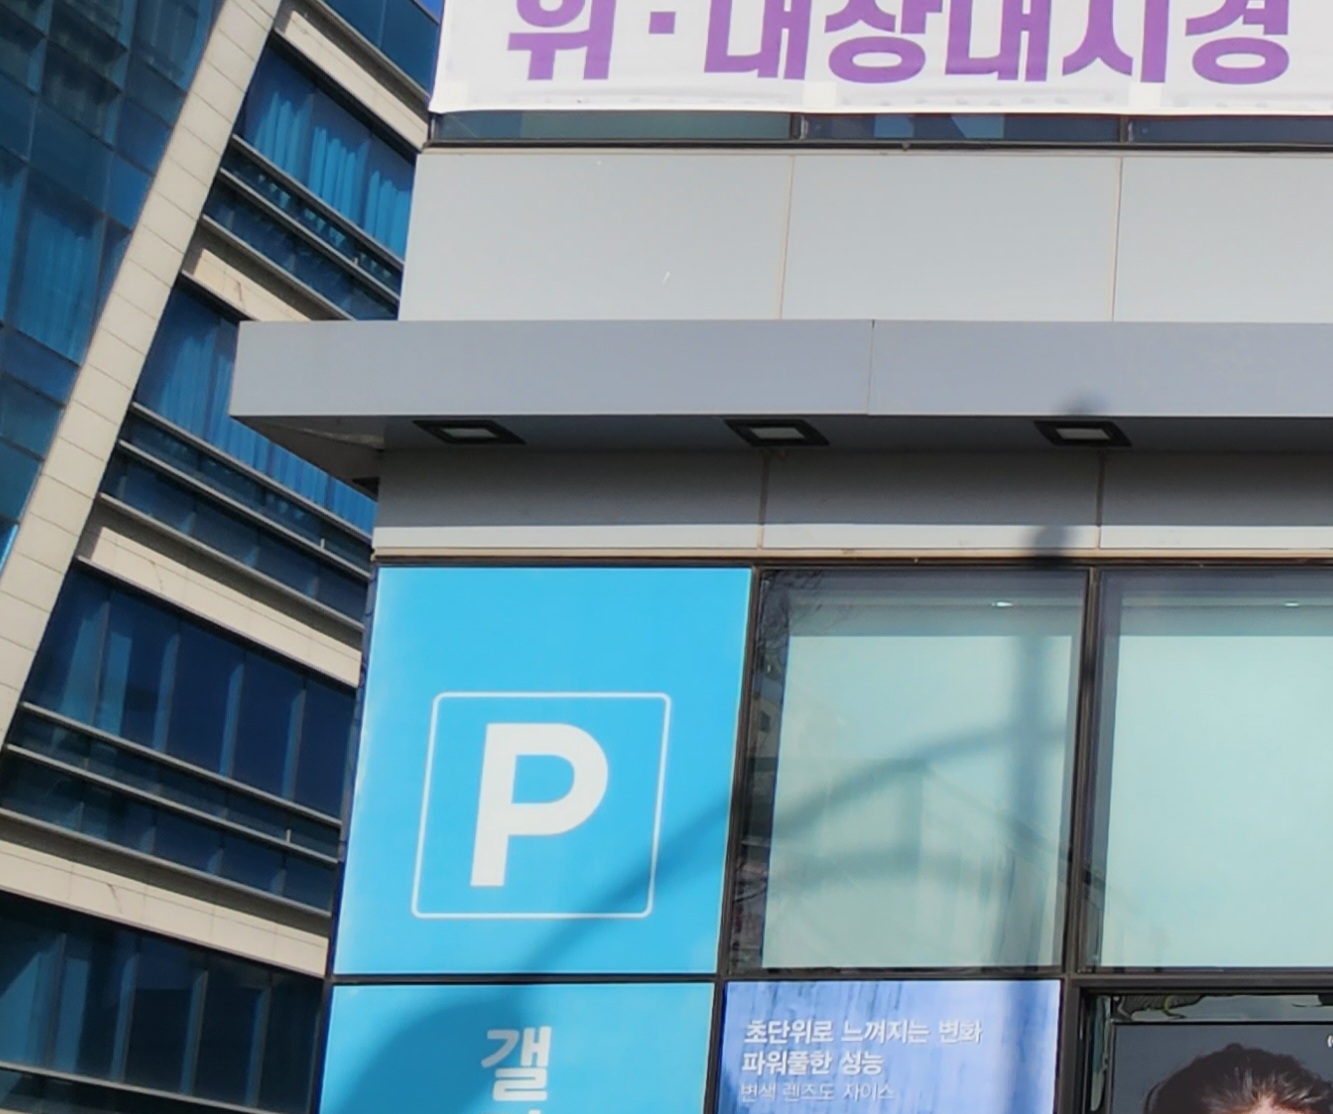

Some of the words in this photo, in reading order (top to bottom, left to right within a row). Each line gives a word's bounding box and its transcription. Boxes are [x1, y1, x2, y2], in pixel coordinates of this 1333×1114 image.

[470, 723, 608, 887] P
[744, 1019, 834, 1044] 초단위로
[841, 1019, 930, 1044] 느껴지는
[939, 1019, 983, 1044] 변화
[741, 1050, 833, 1076] 파워풀한
[841, 1050, 884, 1076] 성능
